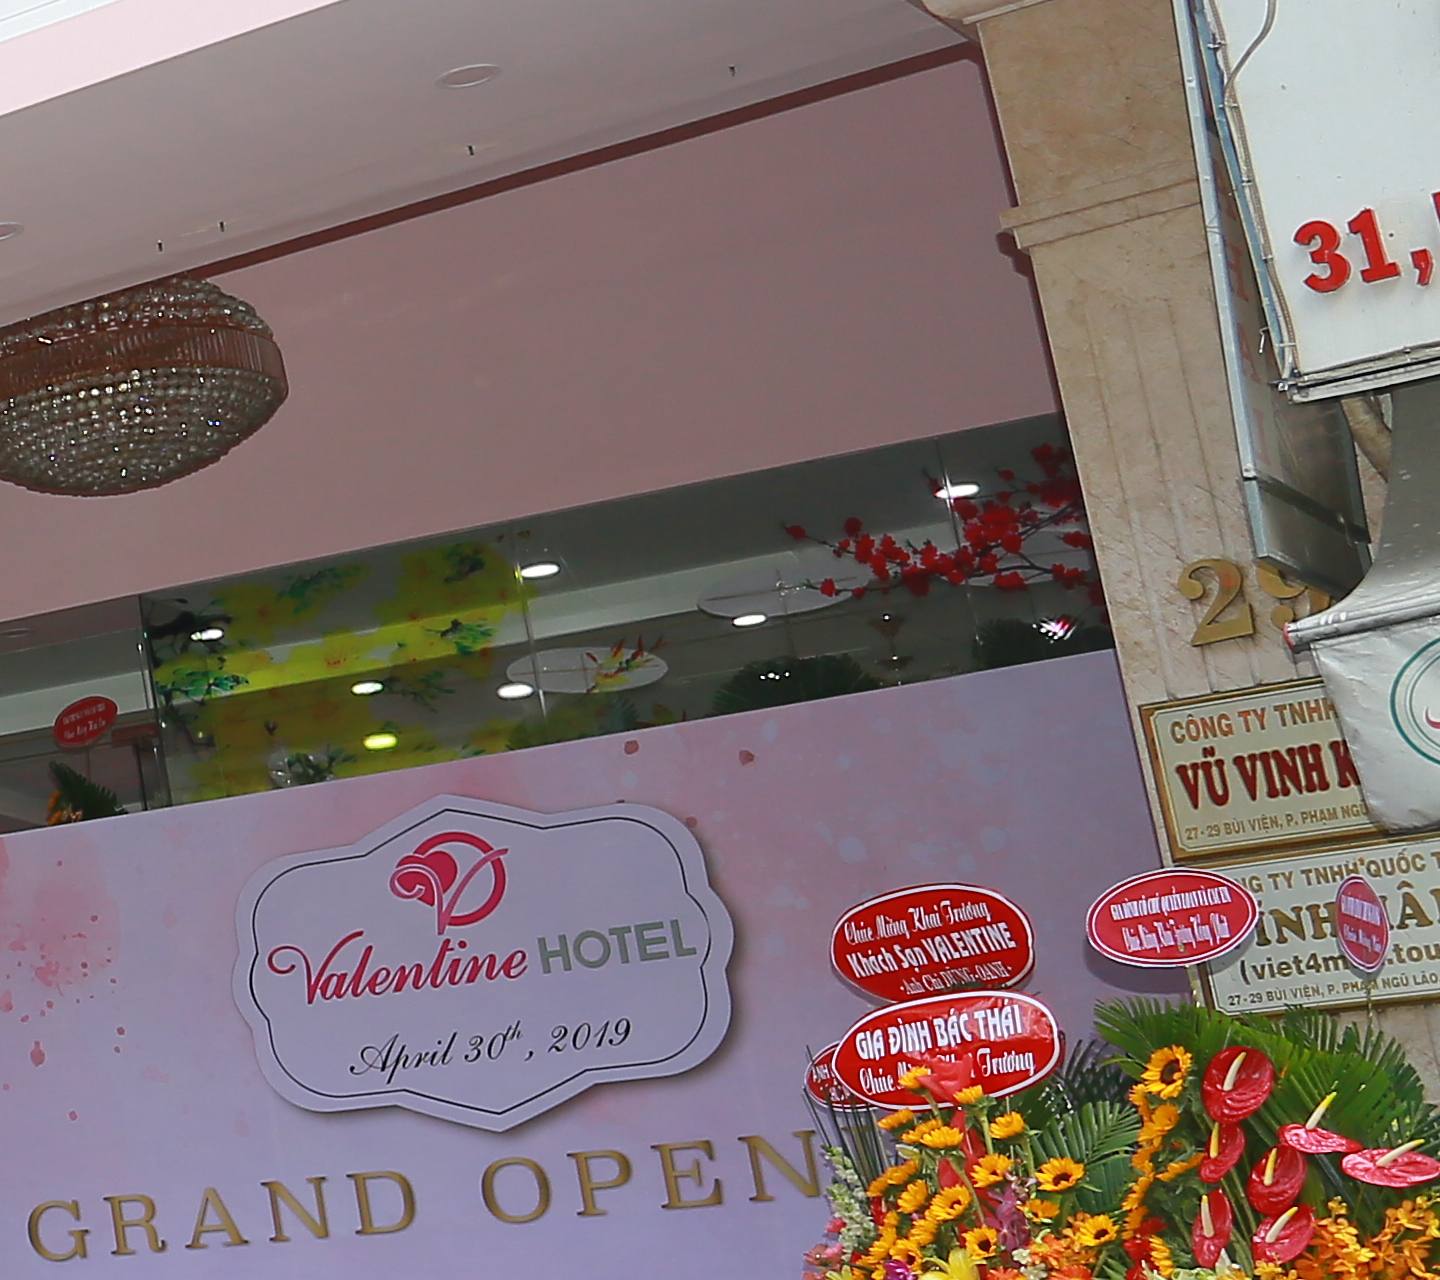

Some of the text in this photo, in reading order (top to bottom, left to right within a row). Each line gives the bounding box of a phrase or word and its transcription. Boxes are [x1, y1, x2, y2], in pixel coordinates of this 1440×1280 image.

[1170, 713, 1235, 744] CÔNG
[1238, 707, 1267, 733] TY
[1176, 745, 1231, 810] VŨ
[1233, 742, 1331, 801] VINH
[1223, 815, 1247, 836] BÙI
[1286, 812, 1300, 828] P.
[1301, 805, 1340, 826] PHẠM
[1268, 871, 1295, 892] TY
[1366, 847, 1427, 879] QUỐC
[844, 921, 874, 946] Chúc
[876, 915, 910, 940] Mừng
[908, 906, 943, 933] Khai
[846, 922, 1017, 979] Khách Sạn VALENTINE
[267, 919, 697, 1005] Valentine HOTEL
[1266, 984, 1289, 1003] BÙI
[1326, 982, 1340, 996] P.
[1382, 970, 1410, 990] NGŨ
[349, 1031, 458, 1085] April
[547, 1017, 631, 1055] 2019
[855, 1001, 1023, 1060] GIA ĐÌNH BÁC THÁI
[859, 1067, 896, 1096] Chúc
[26, 1128, 826, 1263] GRAND OPEN
